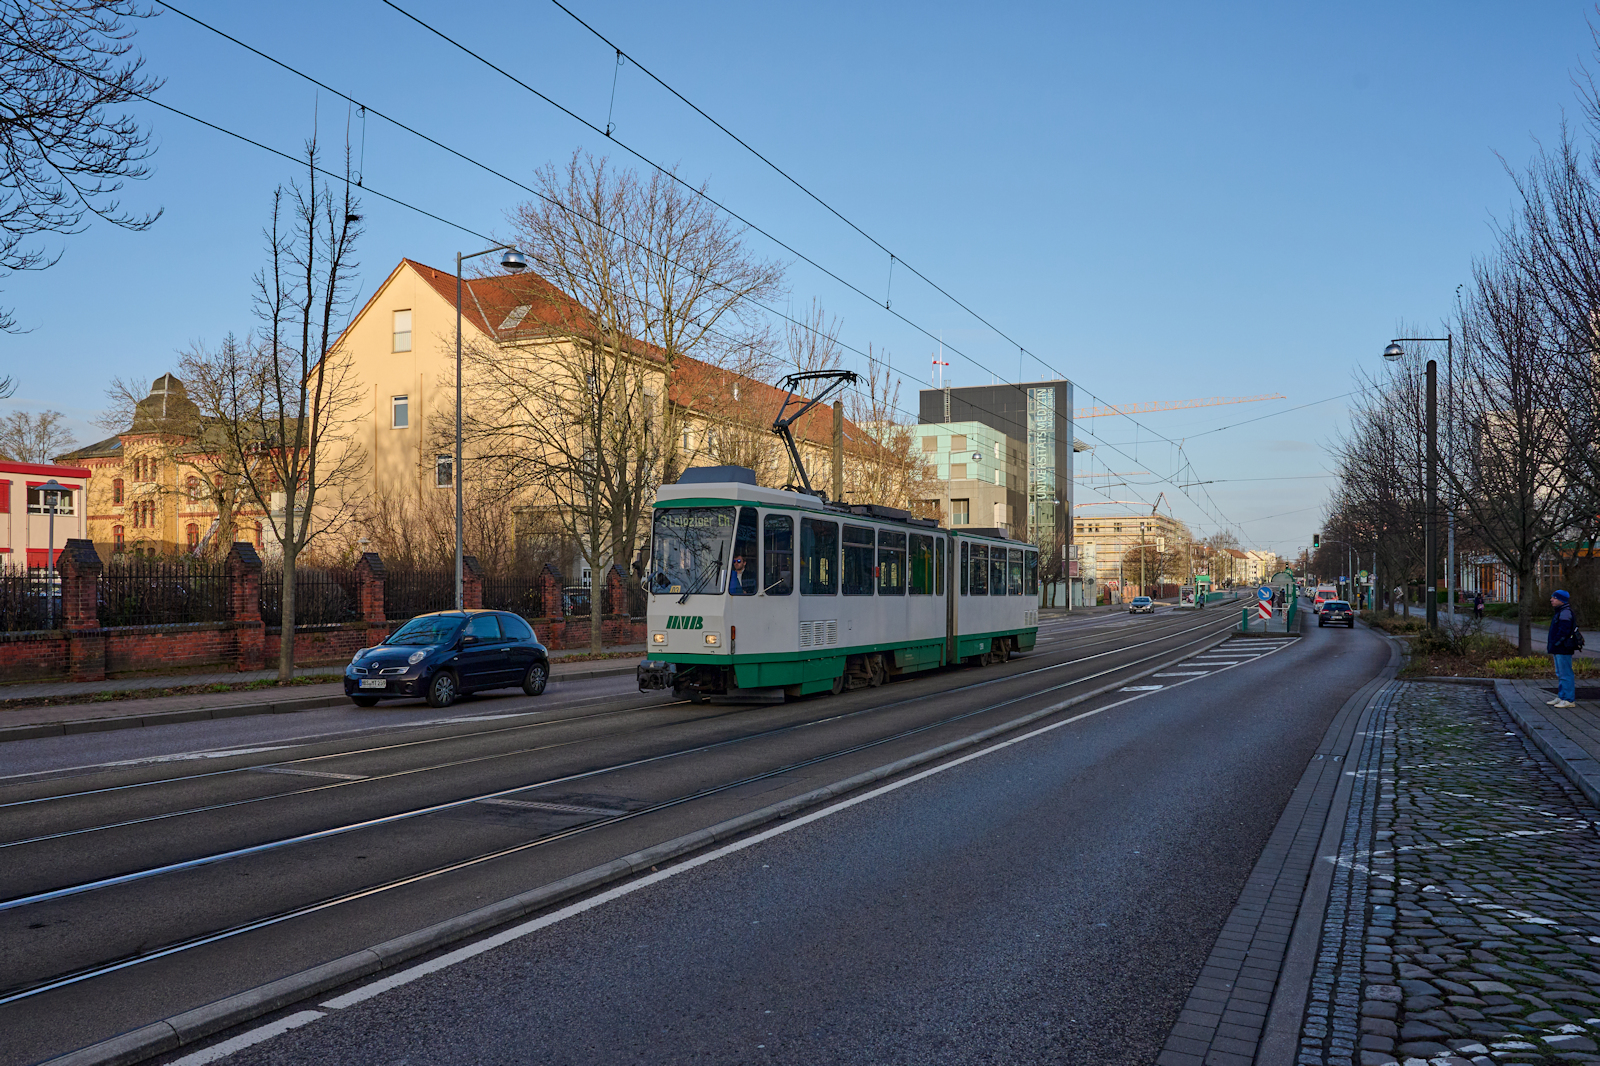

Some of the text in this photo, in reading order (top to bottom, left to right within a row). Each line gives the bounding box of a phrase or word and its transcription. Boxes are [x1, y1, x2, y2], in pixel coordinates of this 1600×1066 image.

[1035, 388, 1047, 499] UNIVERSITÄTSMEDIZIN
[661, 515, 668, 528] 3
[669, 514, 714, 528] Leipziger
[666, 615, 704, 629] MVB
